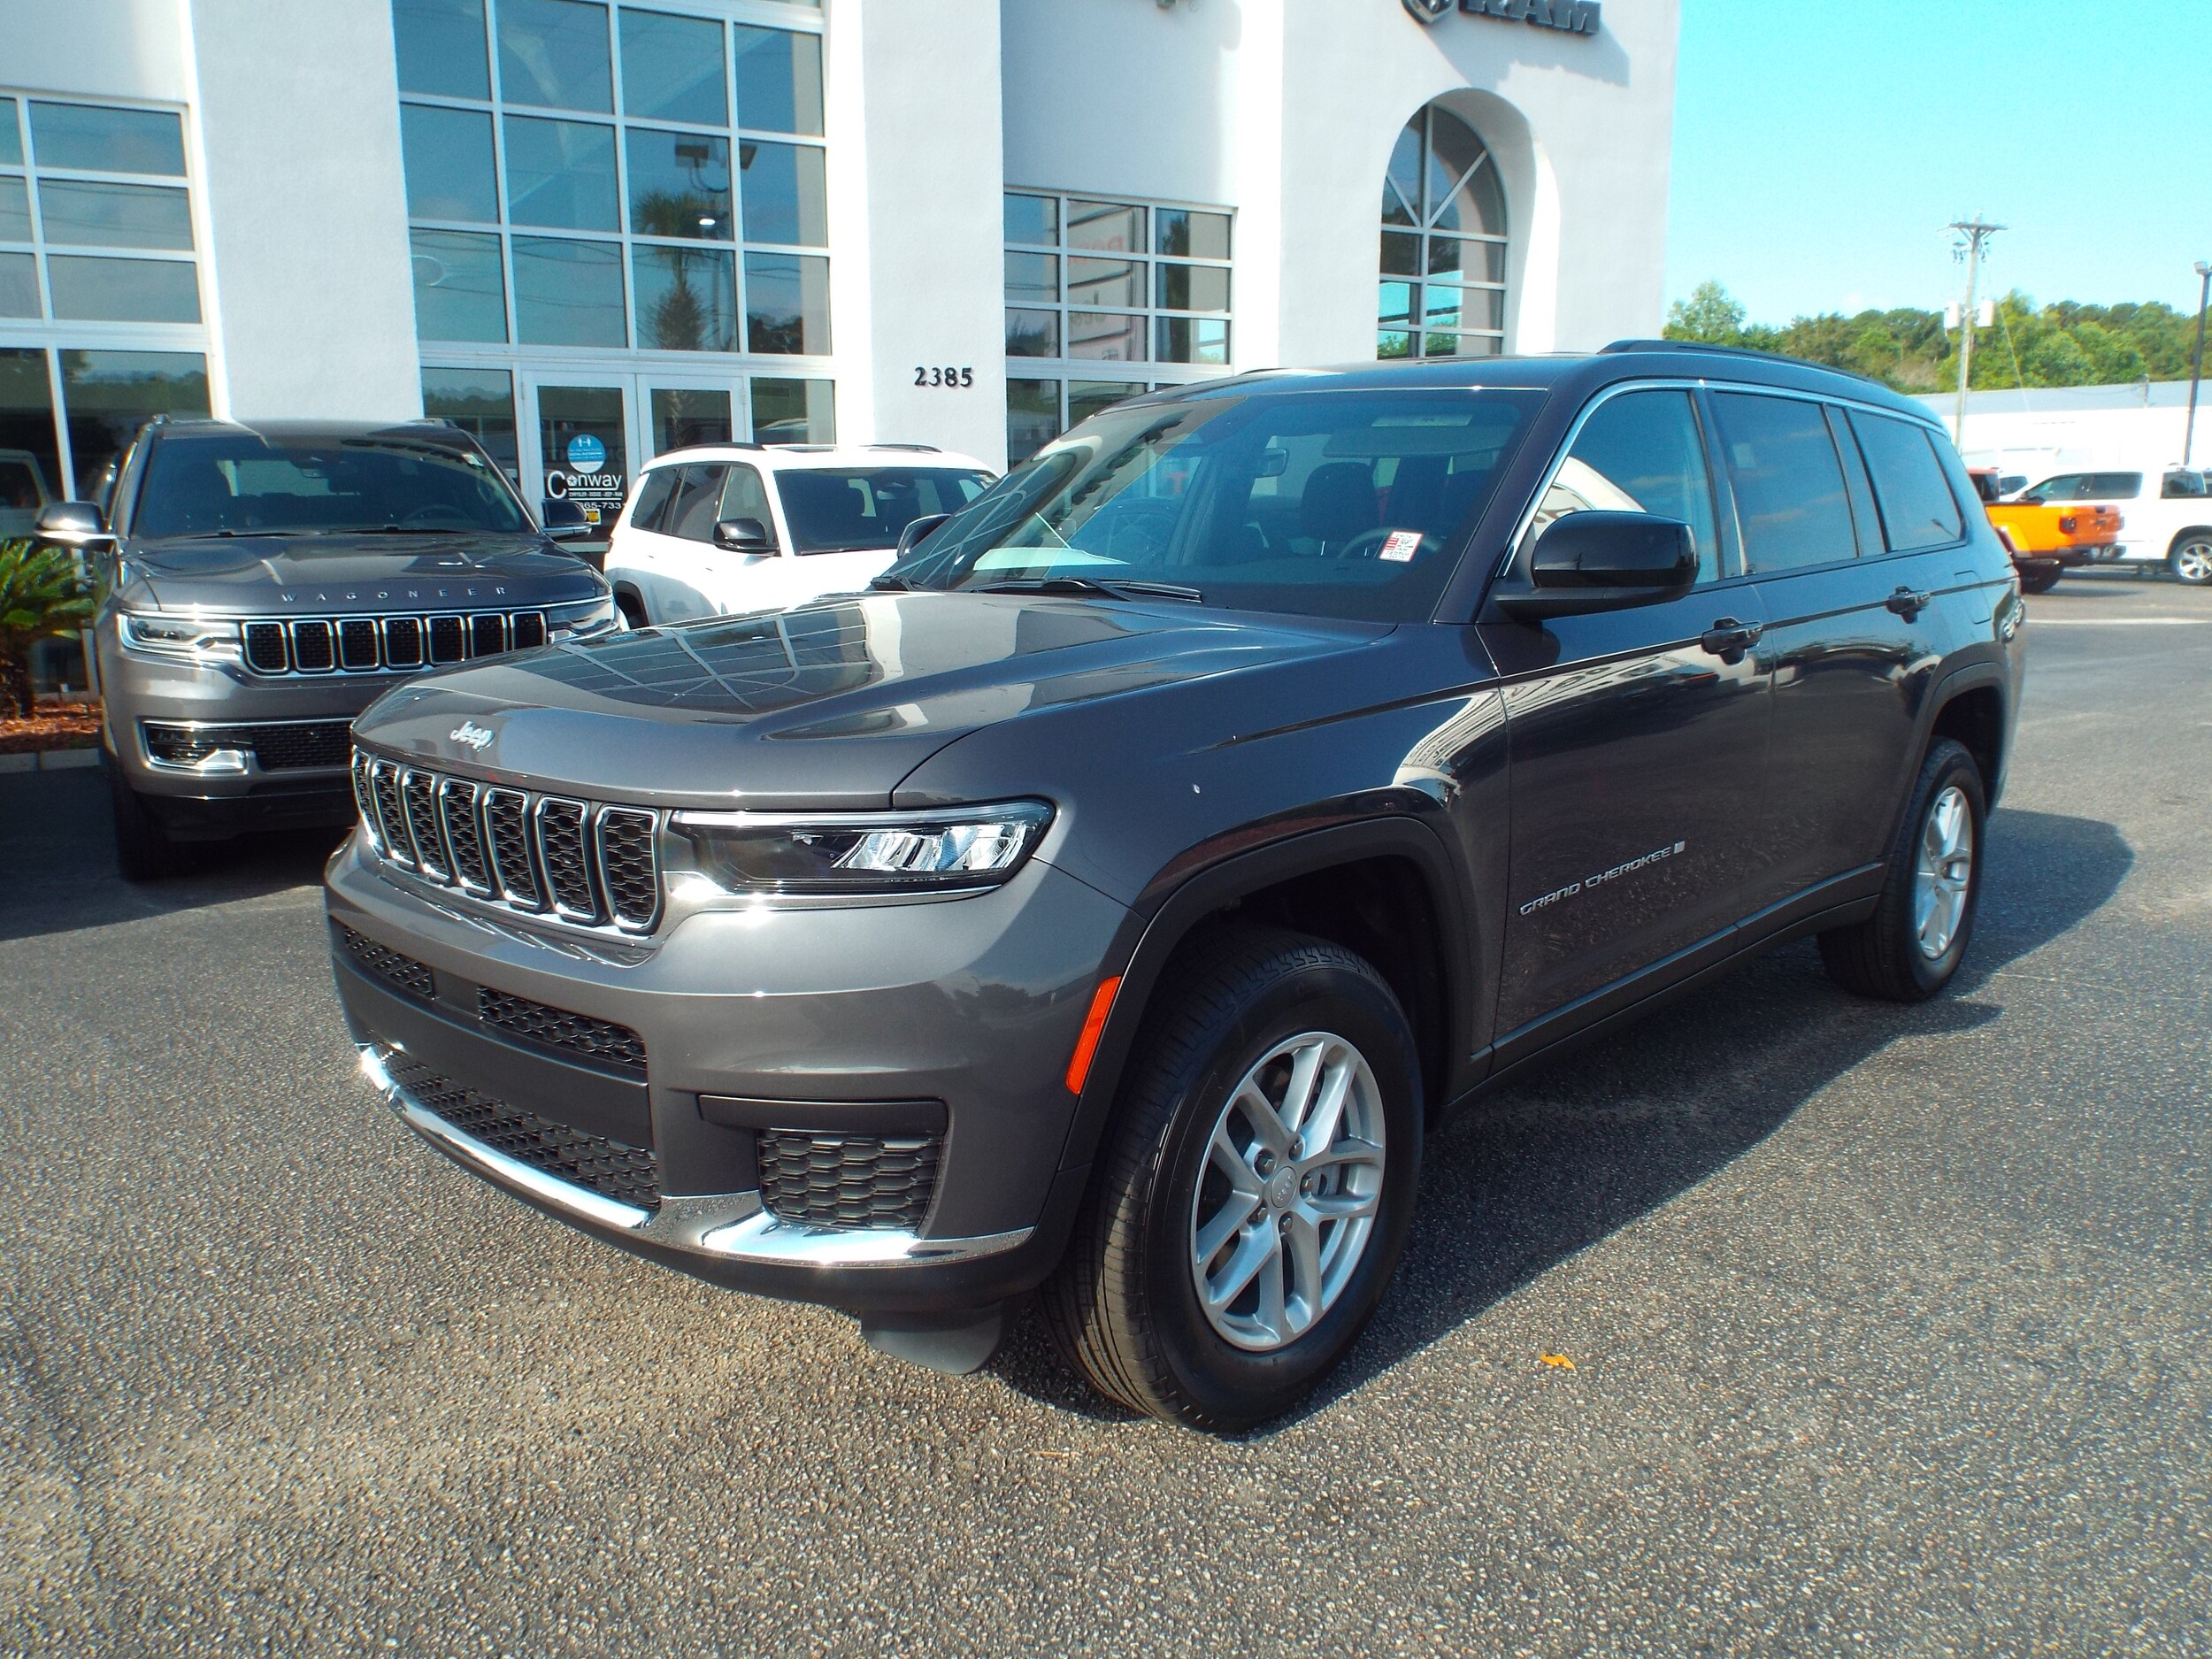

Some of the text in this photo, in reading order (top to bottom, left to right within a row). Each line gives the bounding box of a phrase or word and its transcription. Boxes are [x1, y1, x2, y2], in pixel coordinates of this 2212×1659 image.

[914, 366, 972, 388] 2385
[280, 587, 507, 602] WAGONEER
[449, 720, 495, 750] Jeep
[1518, 882, 1581, 916] GRAND
[1584, 846, 1671, 889] CHEROKEE
